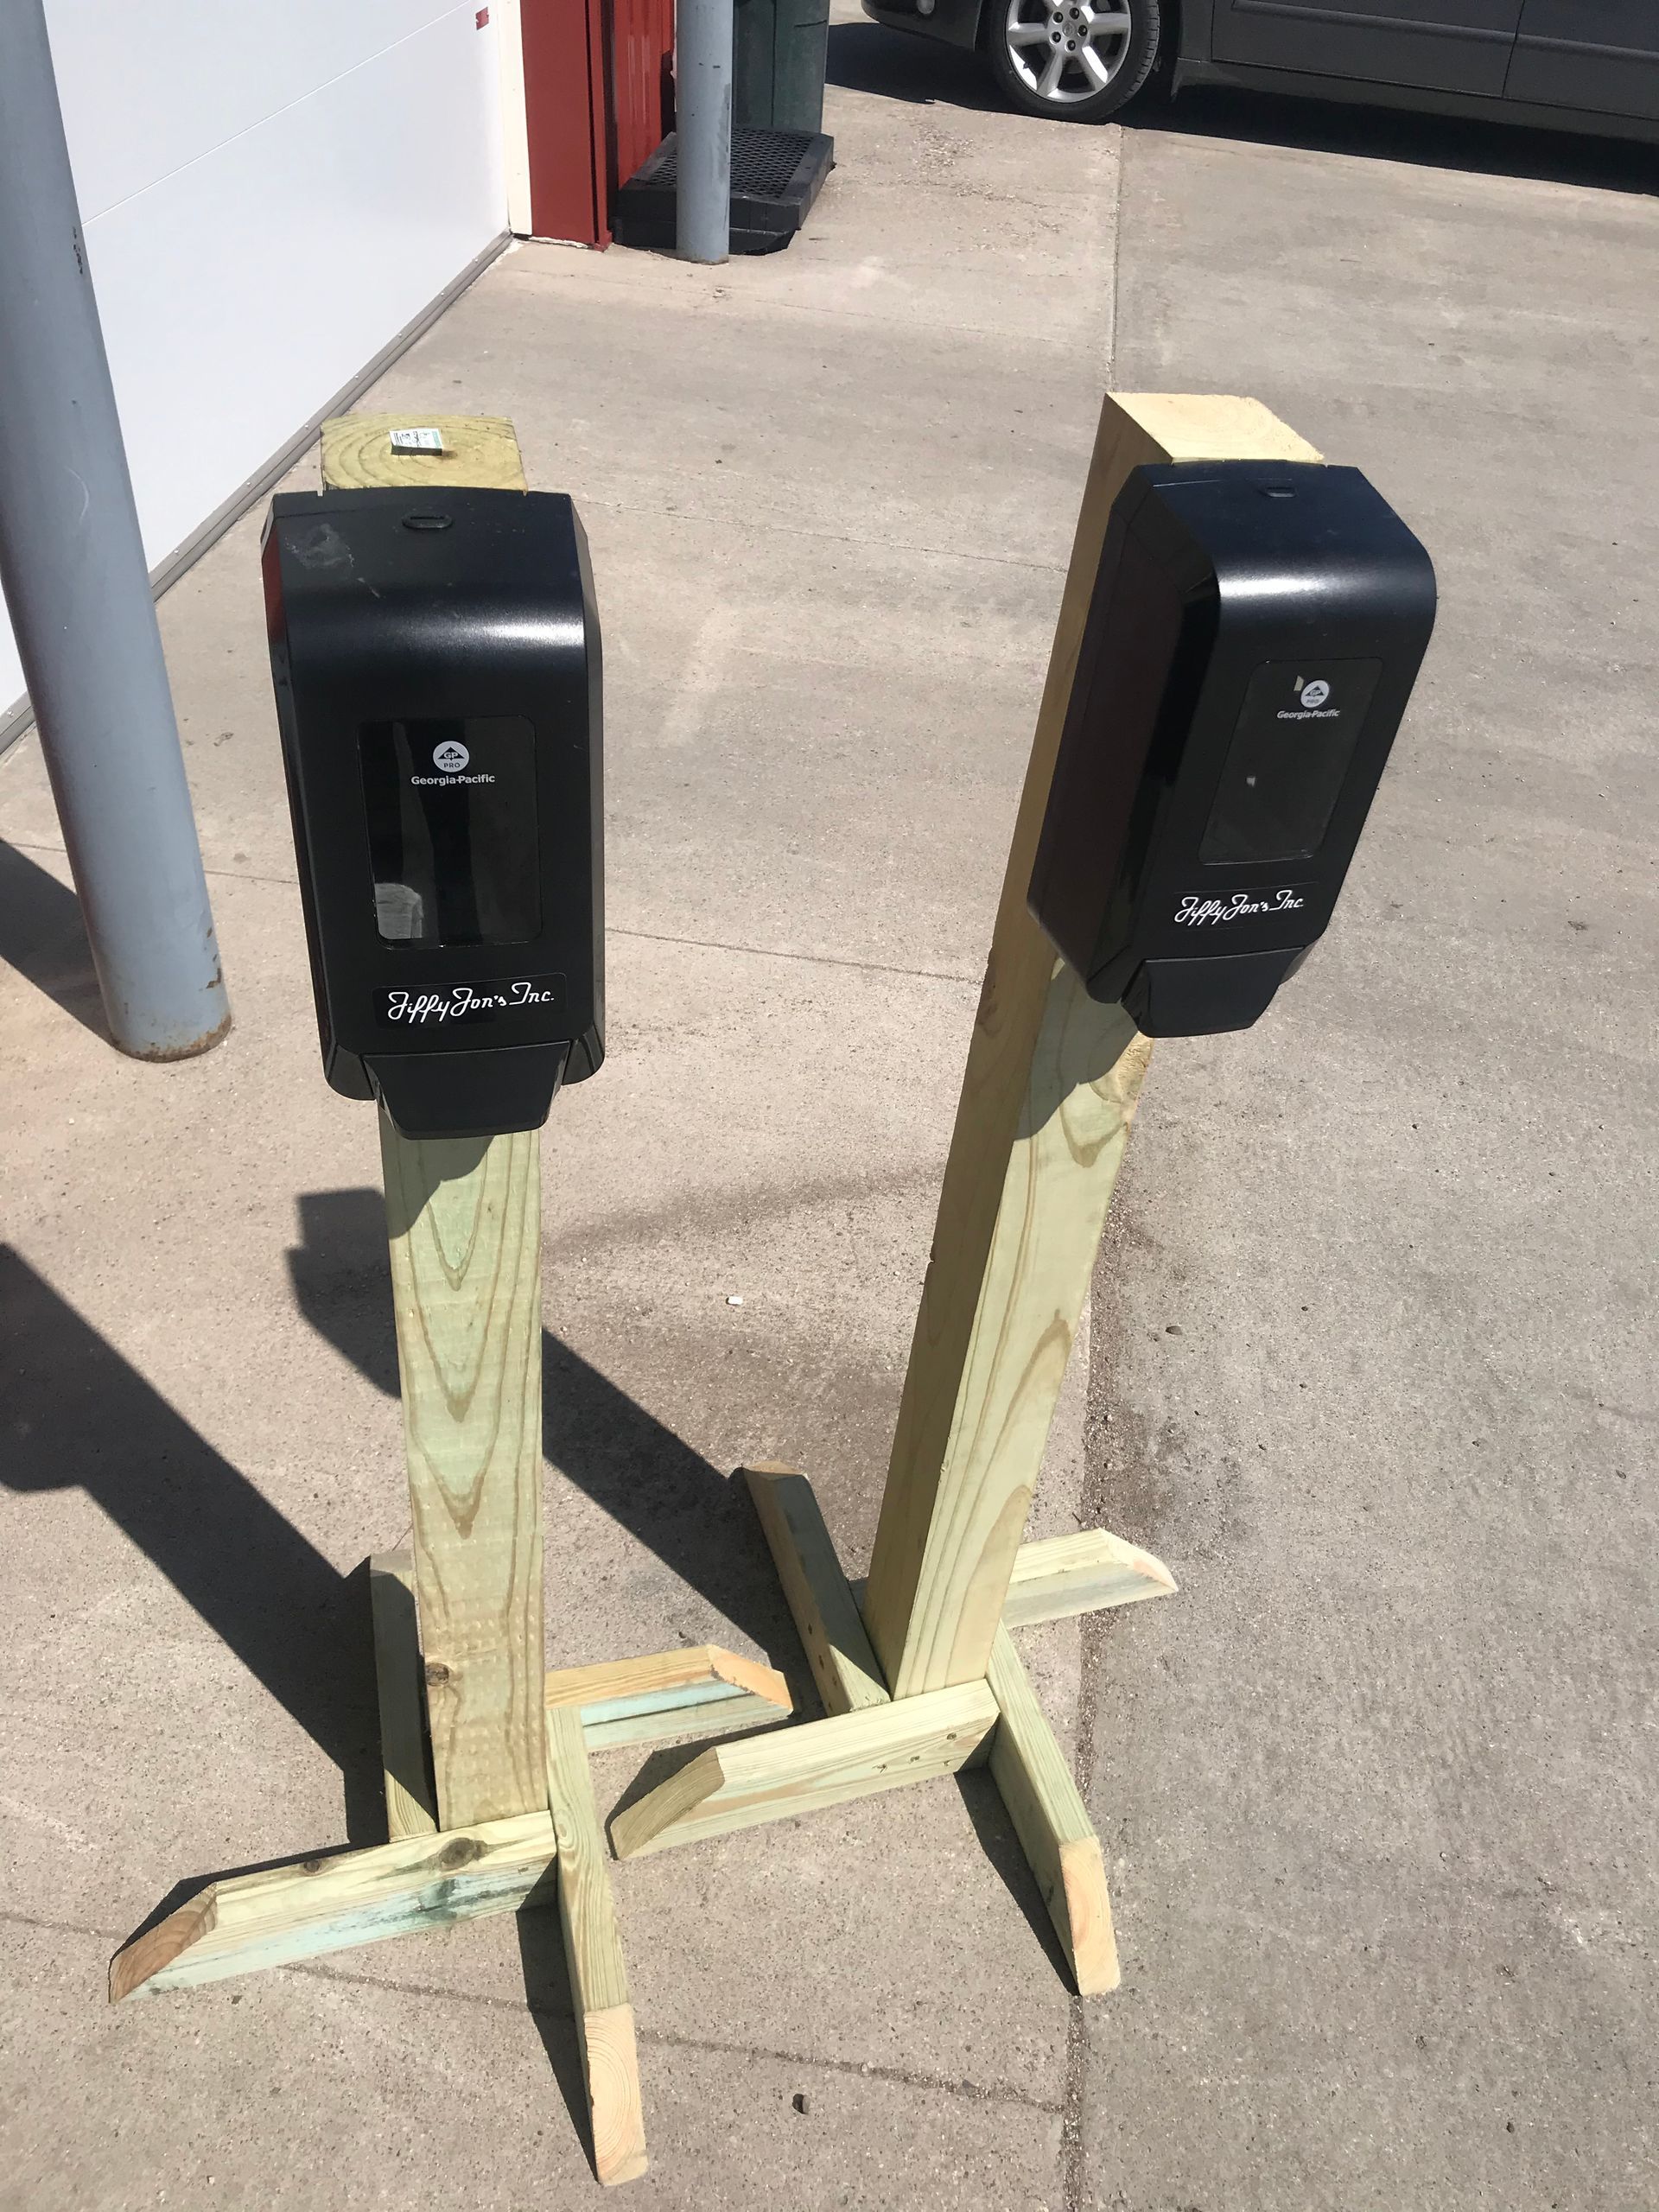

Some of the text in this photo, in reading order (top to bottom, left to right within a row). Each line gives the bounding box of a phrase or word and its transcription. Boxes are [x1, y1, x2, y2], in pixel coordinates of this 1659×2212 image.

[1277, 709, 1341, 720] Georgia-Pacific
[410, 774, 496, 787] Georgia-Pacific
[1174, 896, 1227, 926] Jiffy
[1223, 893, 1269, 920] Jon's
[388, 982, 555, 1023] Jiffy Jon's Inc.
